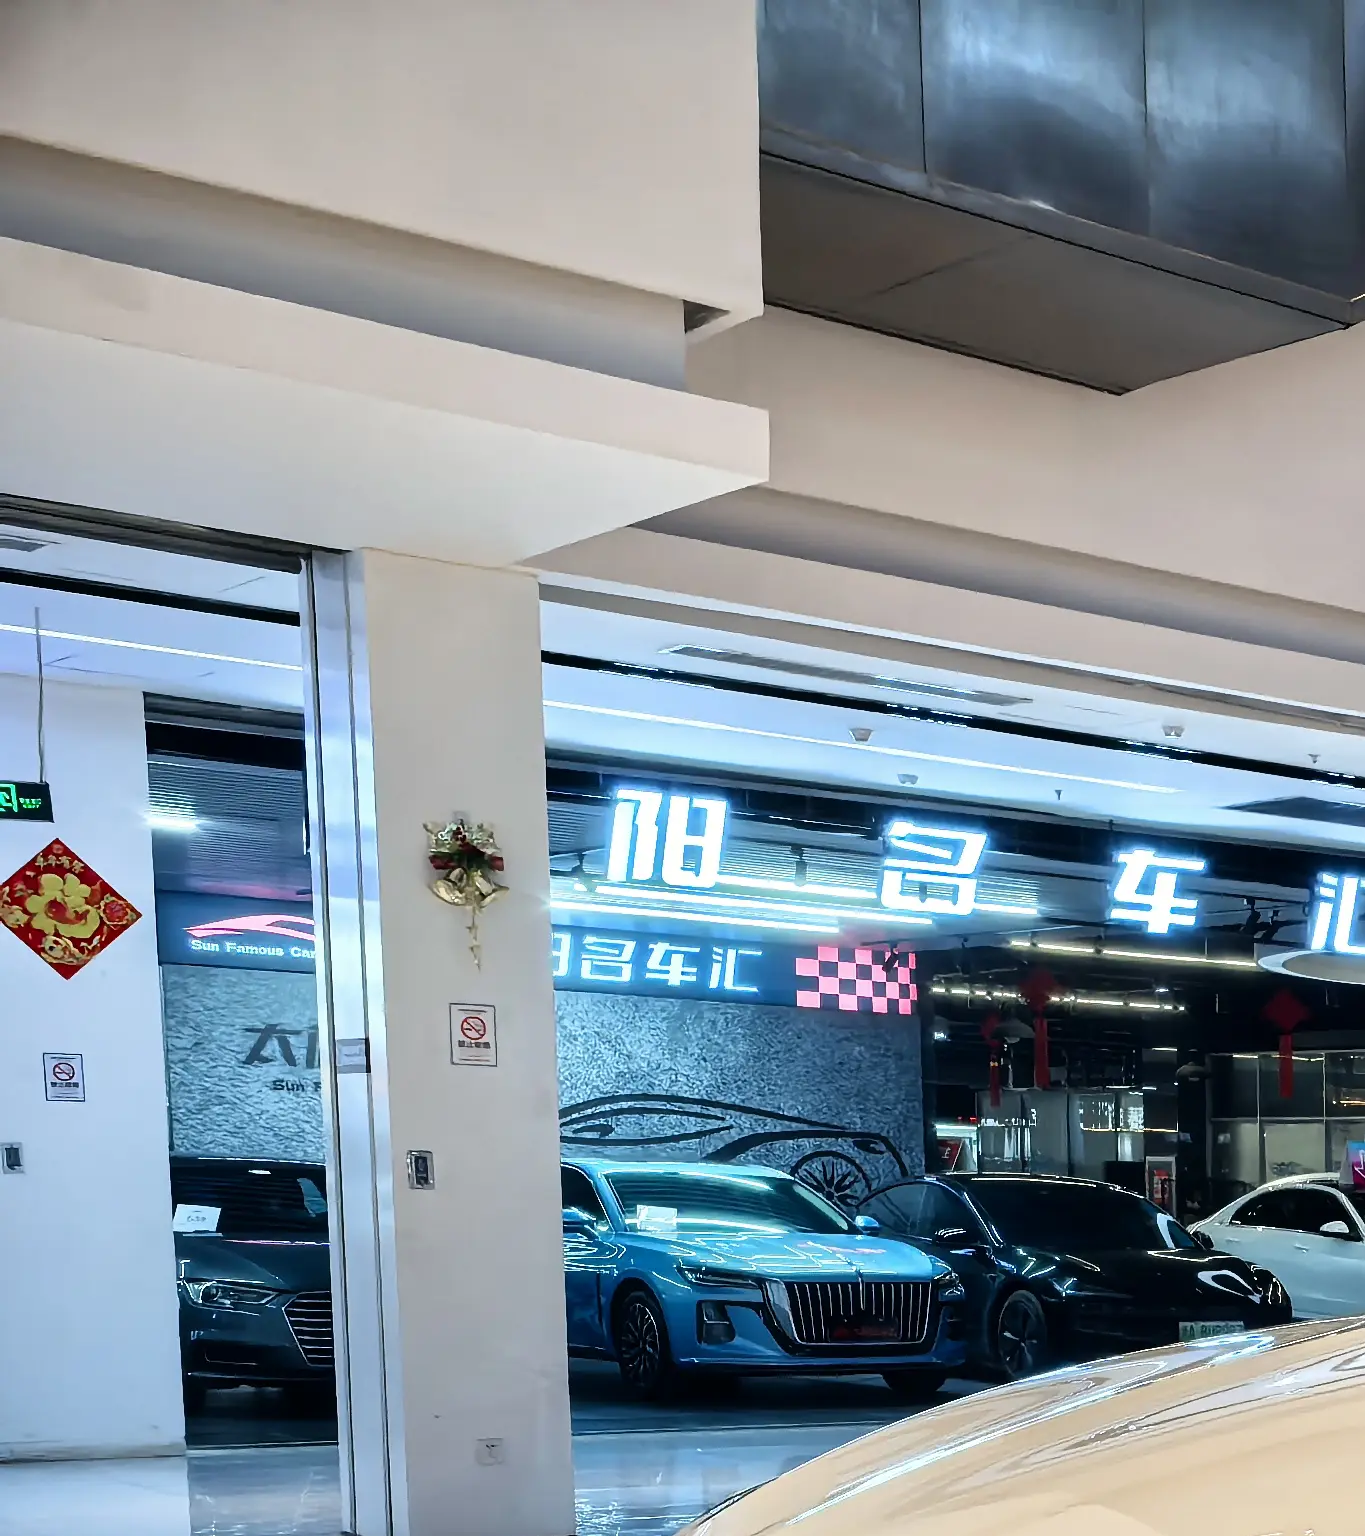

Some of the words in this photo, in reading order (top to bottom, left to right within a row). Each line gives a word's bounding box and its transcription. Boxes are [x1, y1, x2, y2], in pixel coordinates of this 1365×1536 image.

[190, 939, 220, 952] Sun
[226, 942, 285, 957] Famous
[241, 1023, 319, 1069] 太
